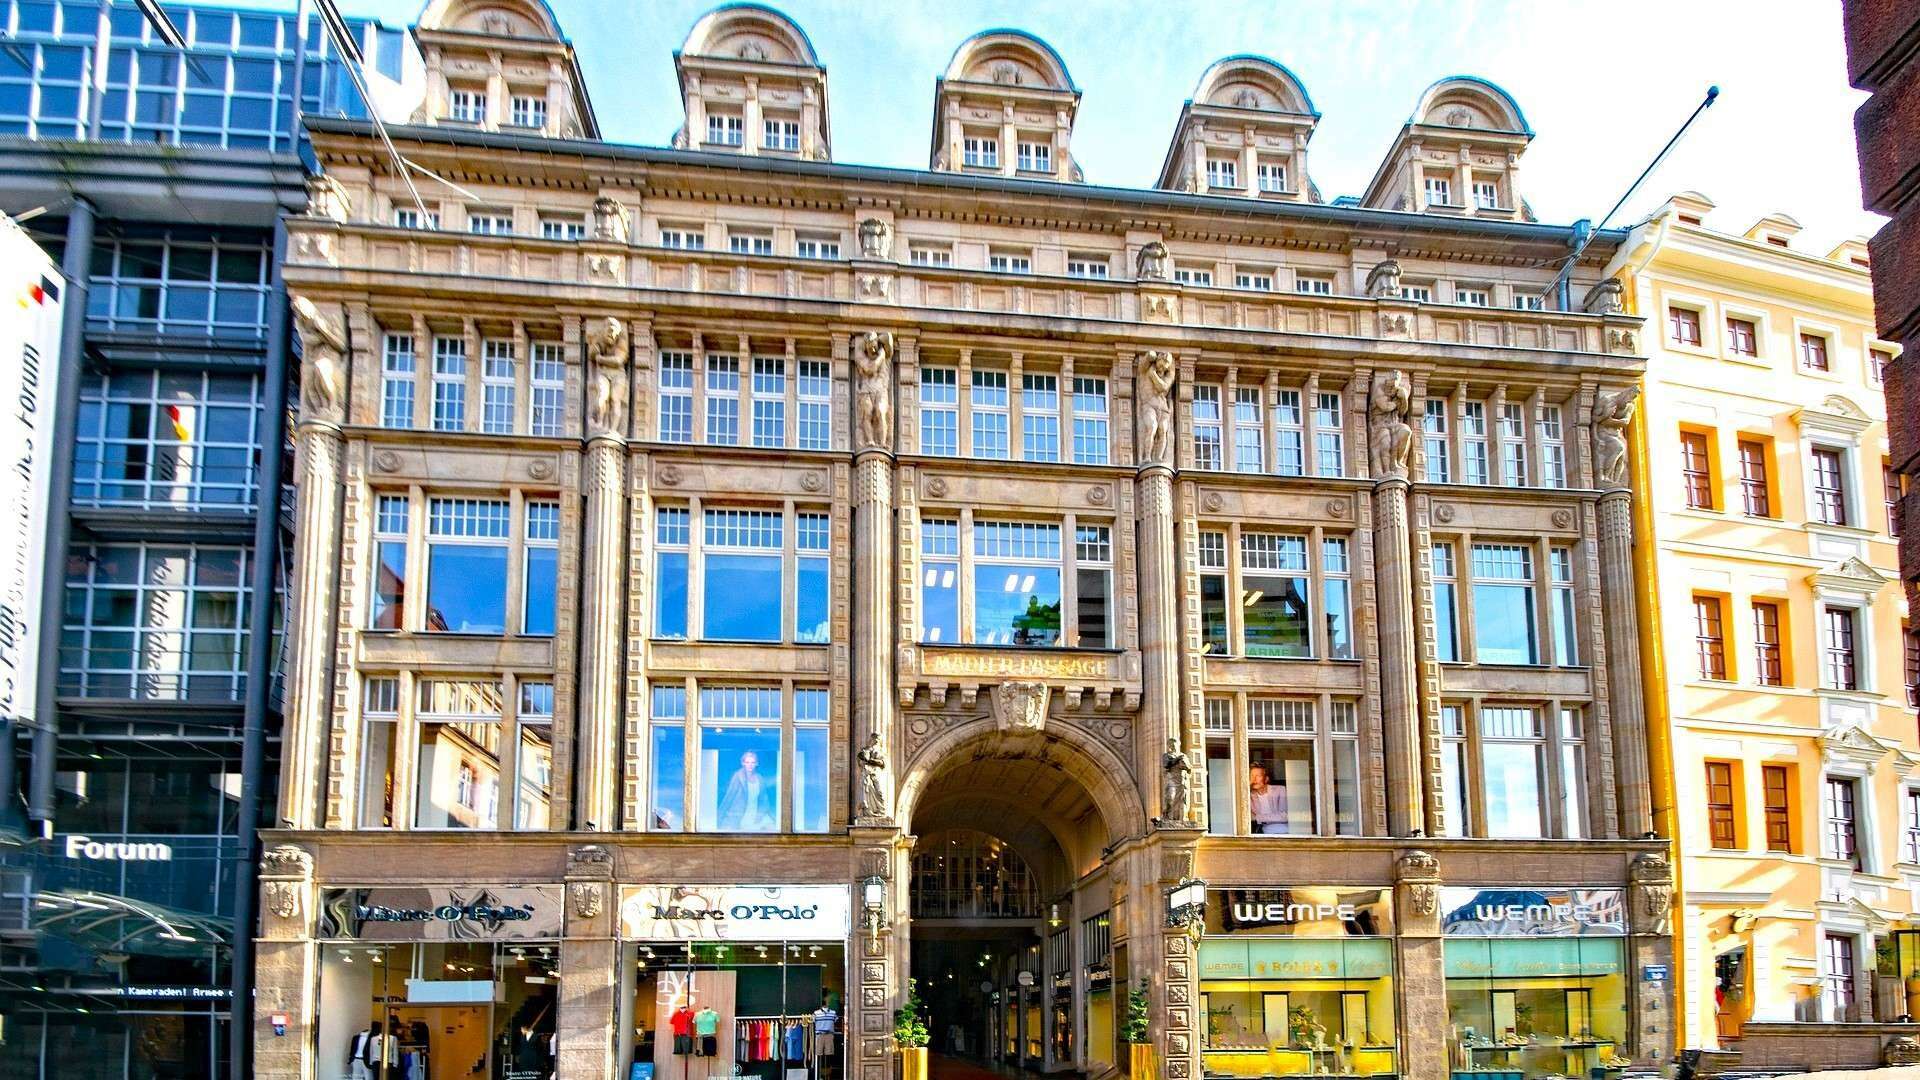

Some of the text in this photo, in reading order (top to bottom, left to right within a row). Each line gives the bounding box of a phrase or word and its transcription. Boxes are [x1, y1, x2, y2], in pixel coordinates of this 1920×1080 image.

[66, 835, 172, 861] Forum
[356, 905, 434, 921] Marc
[652, 905, 725, 920] Marc
[1234, 903, 1356, 921] WEMPE
[1476, 904, 1591, 922] WEMPE
[128, 987, 187, 997] Kameraden!
[193, 988, 225, 997] Armee
